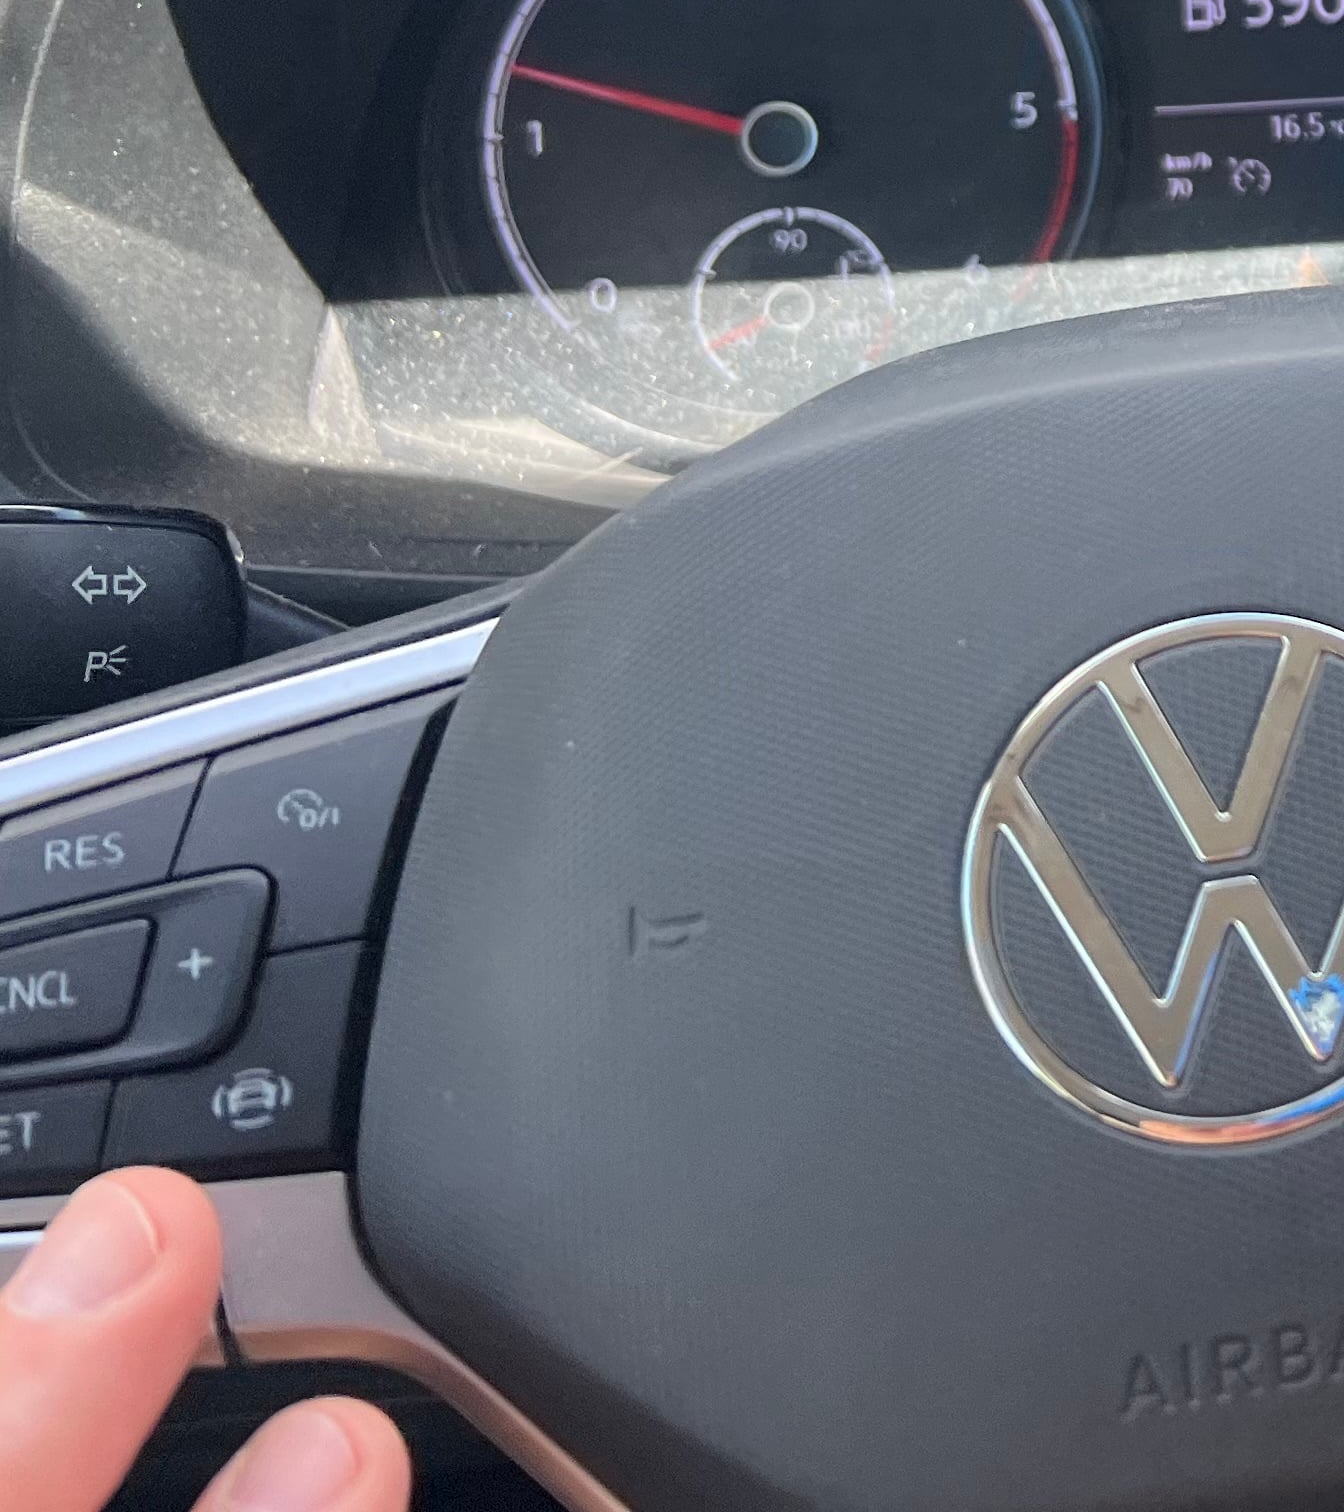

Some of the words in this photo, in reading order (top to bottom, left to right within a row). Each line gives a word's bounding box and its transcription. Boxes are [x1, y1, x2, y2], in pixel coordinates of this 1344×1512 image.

[1009, 91, 1038, 128] 5
[526, 120, 544, 156] 1
[588, 276, 618, 314] 0
[43, 832, 126, 873] RES
